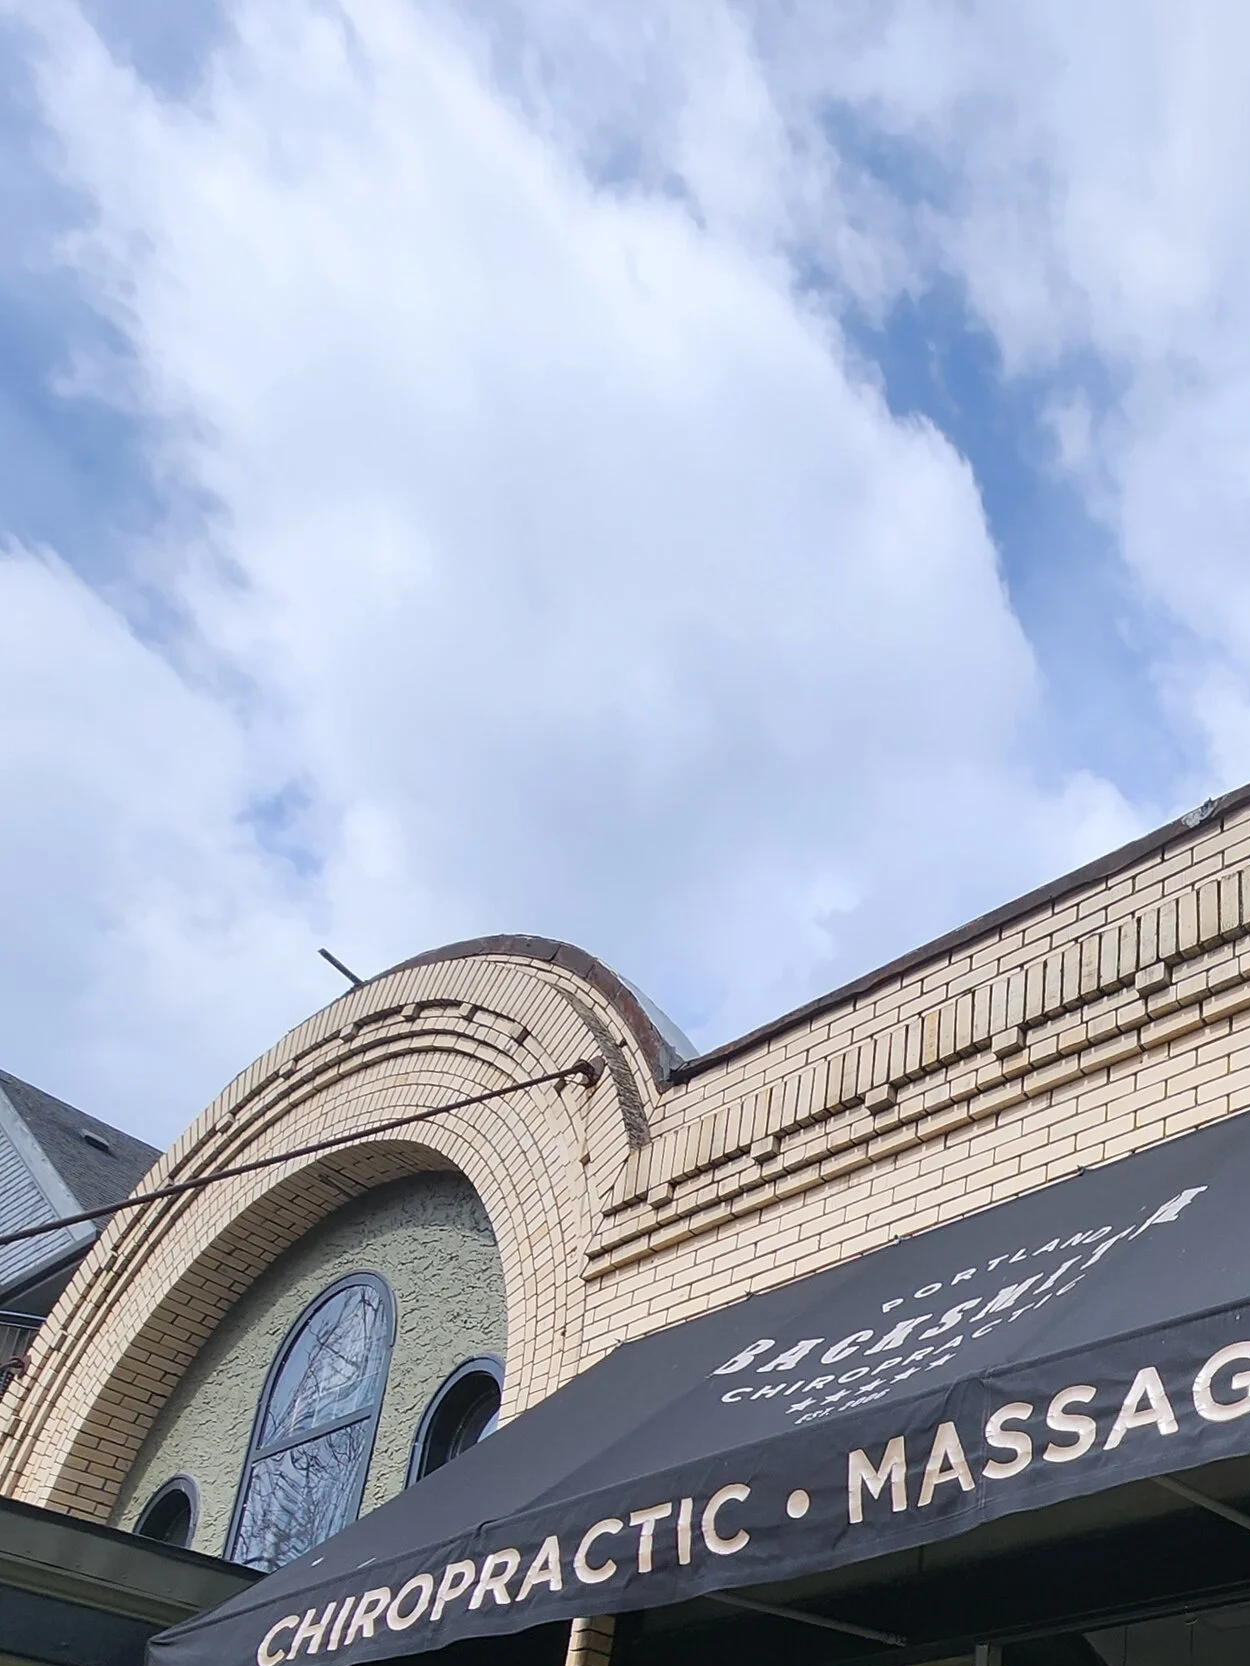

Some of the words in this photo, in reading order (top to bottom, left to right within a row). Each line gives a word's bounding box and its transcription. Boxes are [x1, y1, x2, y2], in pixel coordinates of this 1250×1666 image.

[710, 1185, 1208, 1378] BACKSMITH
[881, 1225, 1113, 1314] PORTLAND
[720, 1273, 1089, 1404] CHIROPRACTIC
